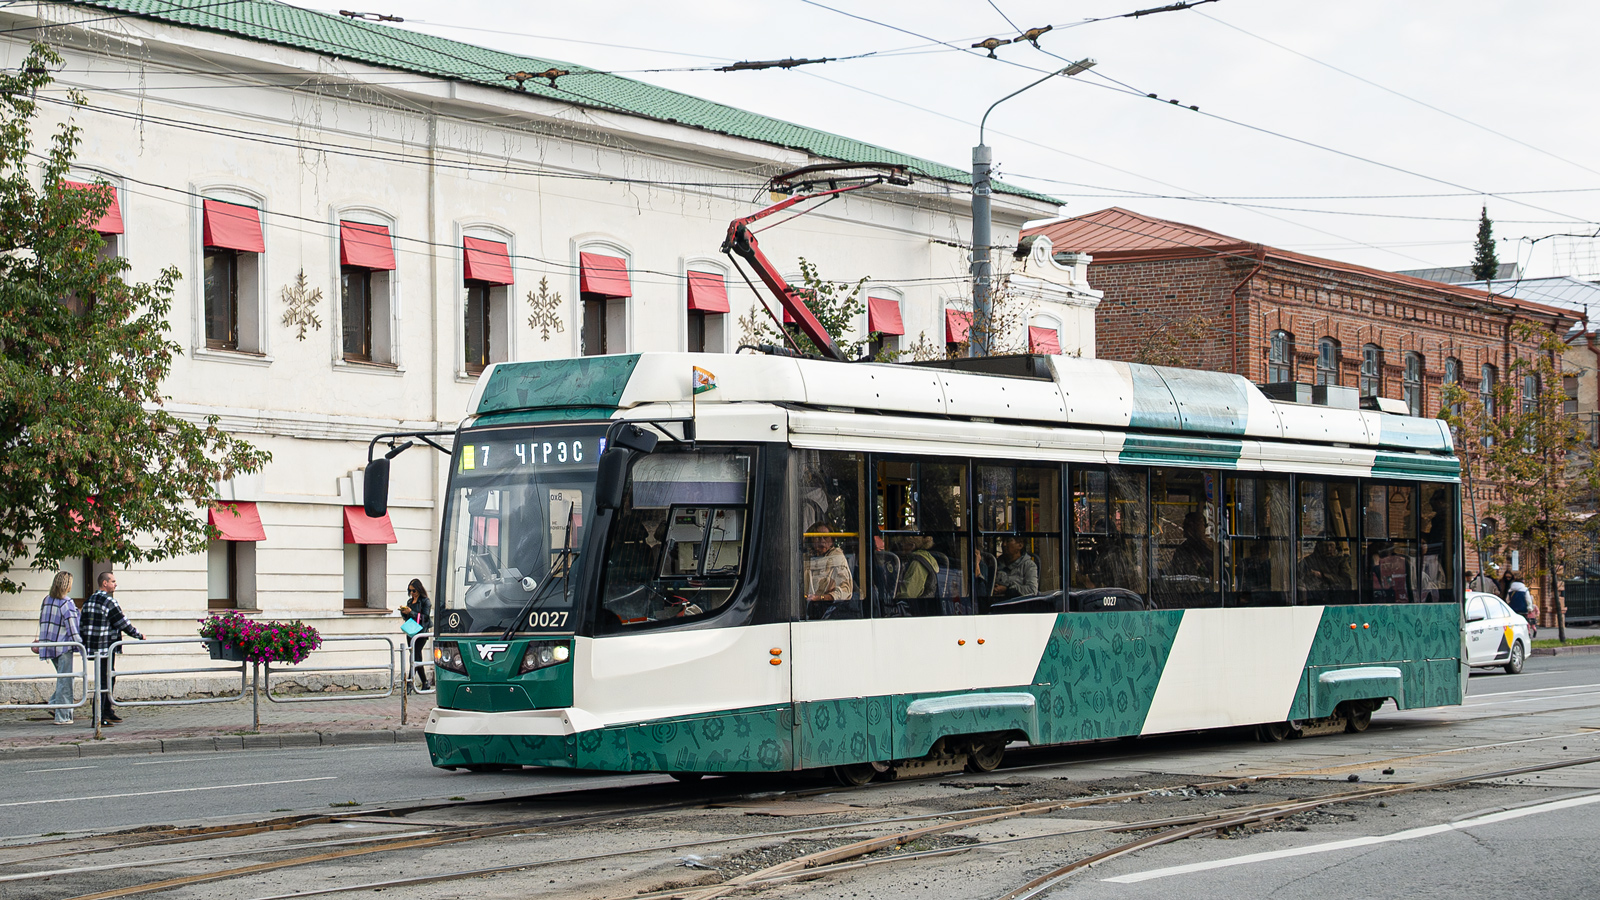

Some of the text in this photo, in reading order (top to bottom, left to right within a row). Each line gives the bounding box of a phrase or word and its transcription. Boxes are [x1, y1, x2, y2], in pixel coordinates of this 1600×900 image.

[481, 440, 583, 467] 7 ЧГРЭС
[1103, 596, 1117, 606] 0027
[528, 611, 569, 628] 0027
